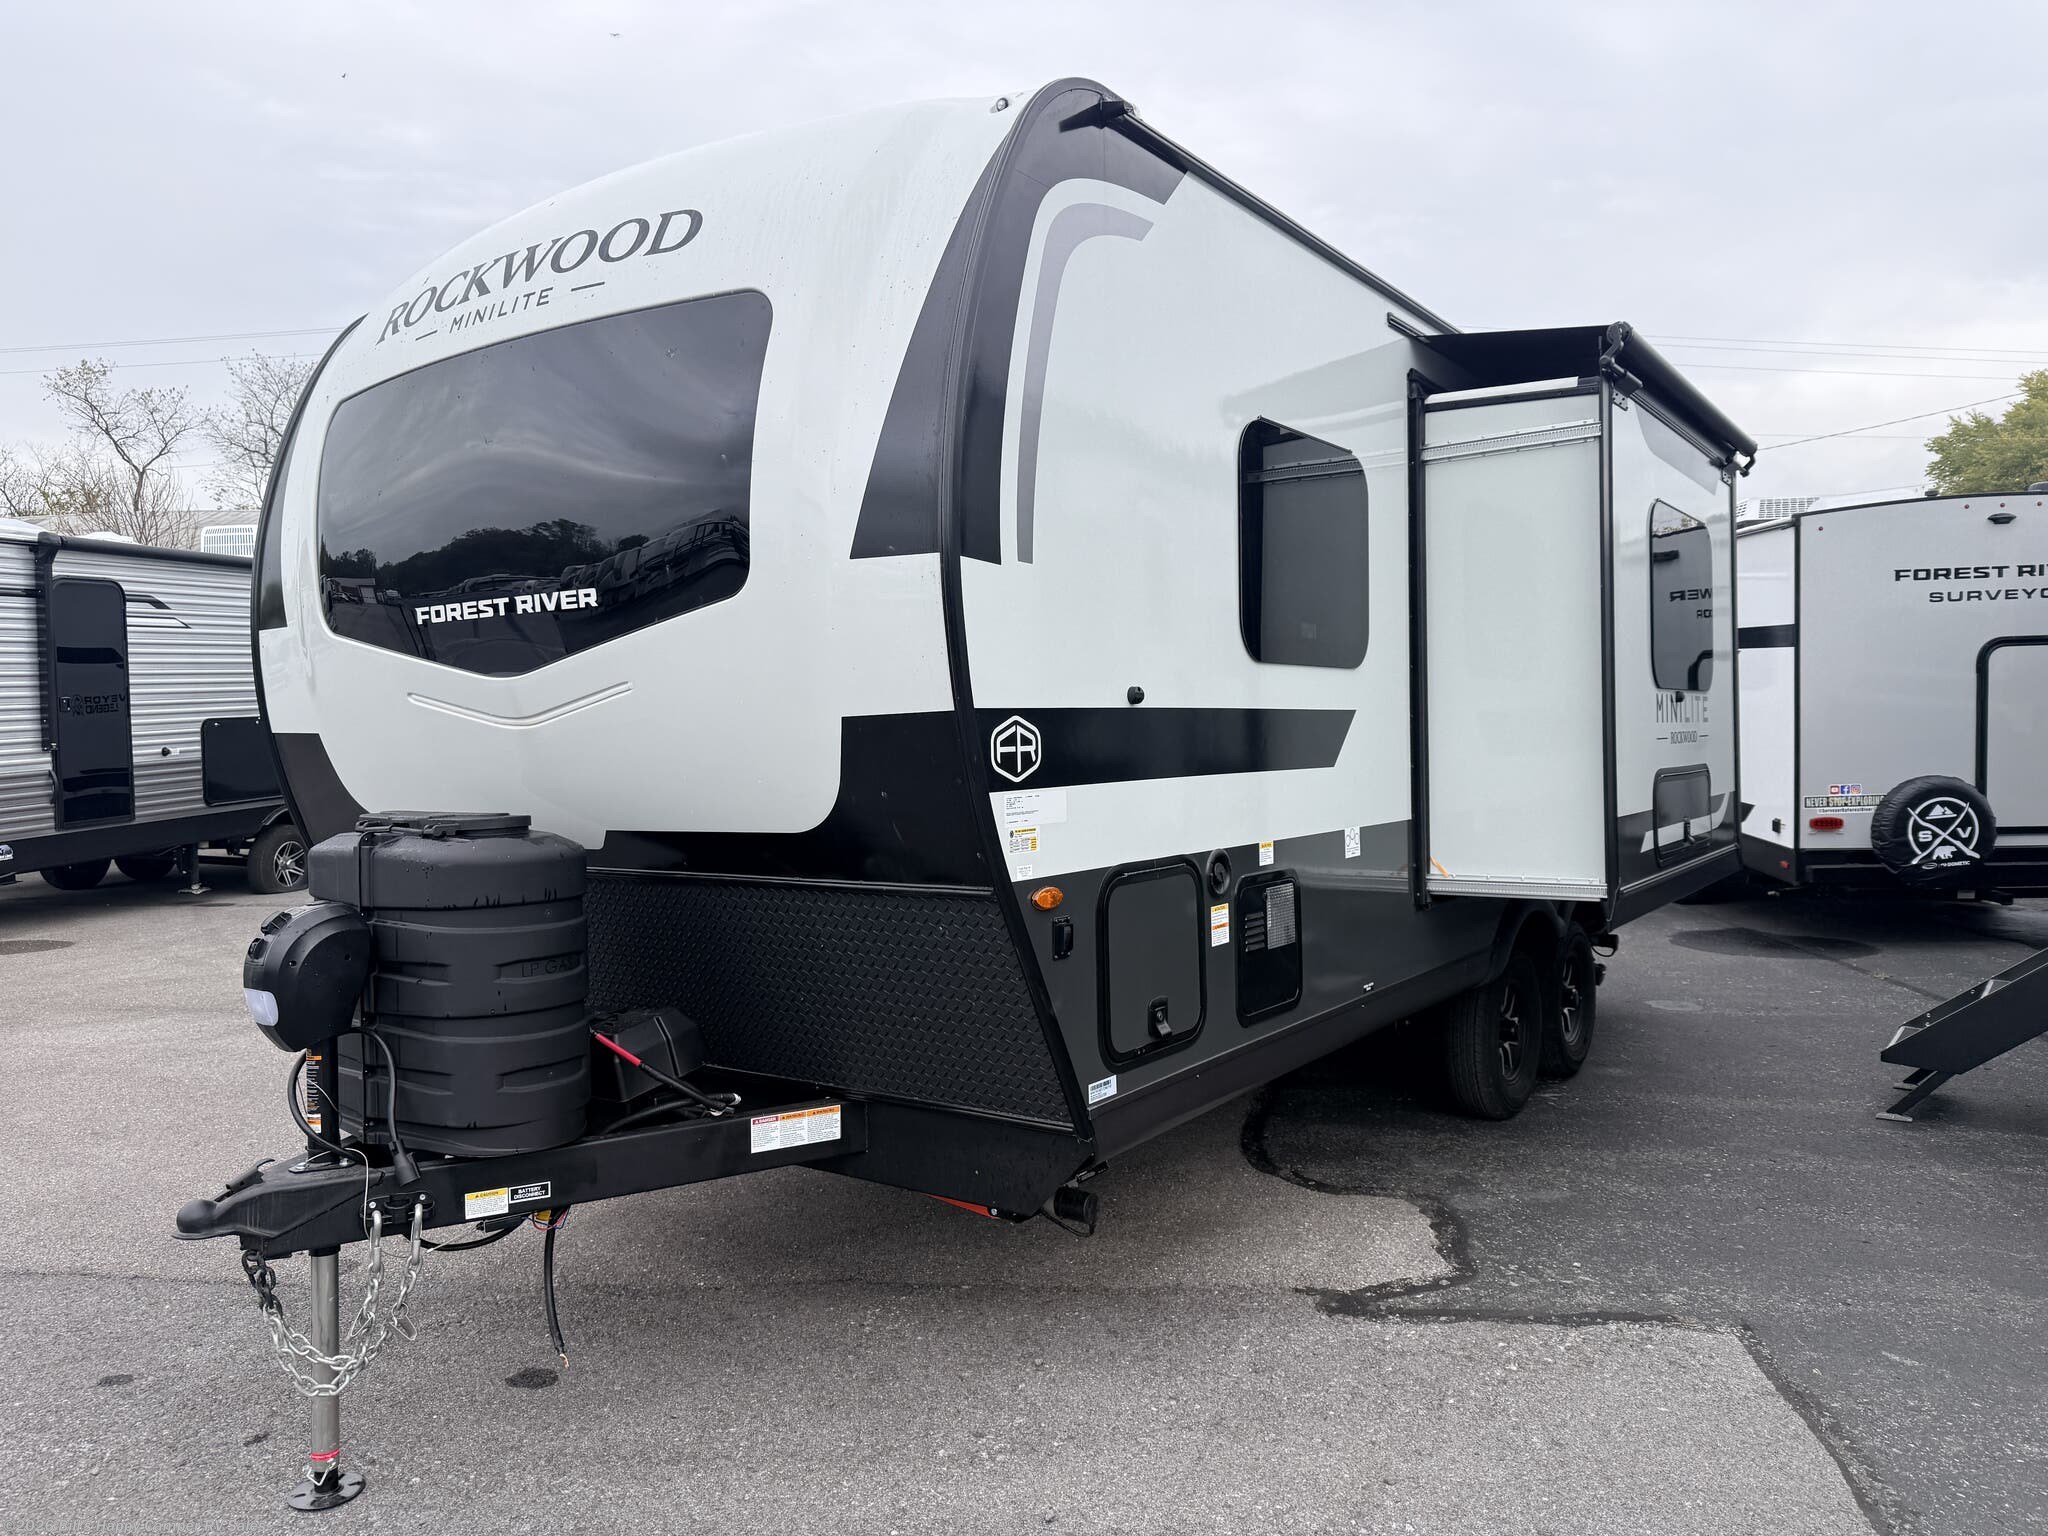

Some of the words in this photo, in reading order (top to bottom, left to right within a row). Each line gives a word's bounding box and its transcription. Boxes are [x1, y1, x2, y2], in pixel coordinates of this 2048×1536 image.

[376, 208, 704, 345] ROCKWOOD
[449, 286, 554, 334] MINILITE
[1894, 565, 2010, 581] FOREST
[2017, 563, 2048, 577] RI
[415, 596, 510, 625] FOREST
[514, 587, 599, 615] RIVER
[1656, 692, 1709, 724] MINILITE
[1670, 731, 1698, 745] ROCKWOOD
[1805, 797, 1828, 808] NEVER
[1918, 830, 1933, 842] S
[1956, 826, 1973, 838] V
[518, 1186, 541, 1194] BATTERY
